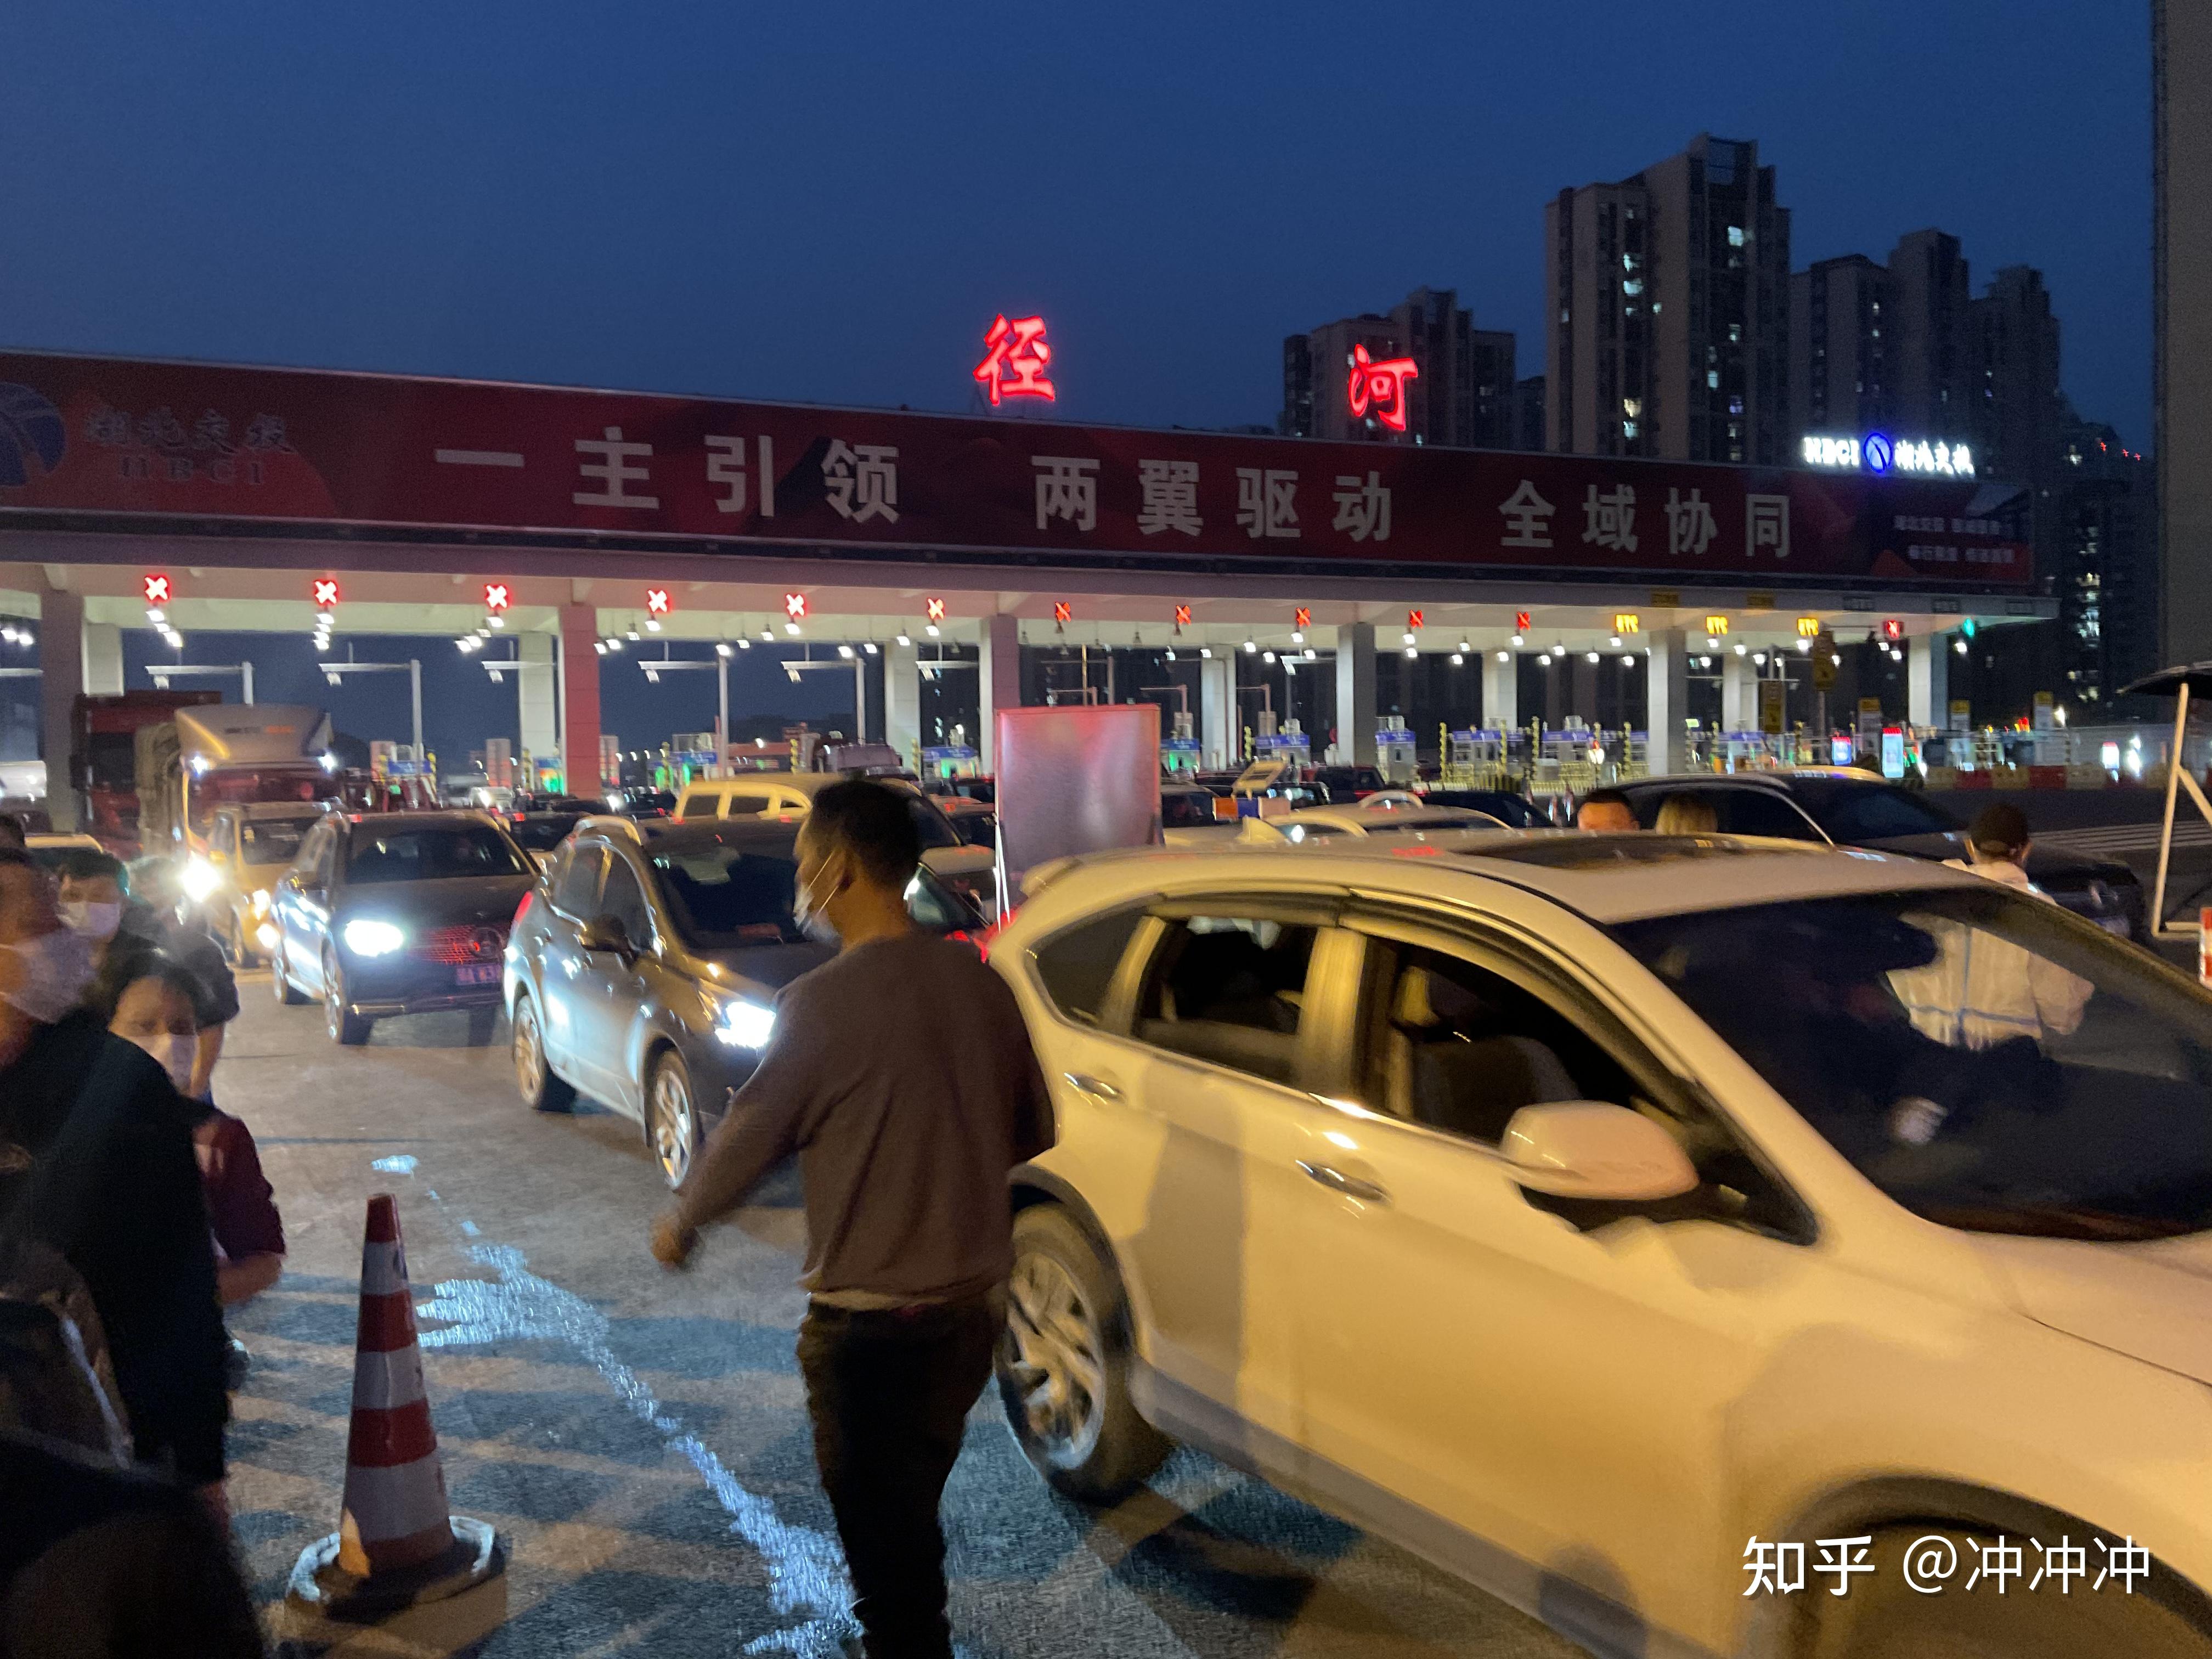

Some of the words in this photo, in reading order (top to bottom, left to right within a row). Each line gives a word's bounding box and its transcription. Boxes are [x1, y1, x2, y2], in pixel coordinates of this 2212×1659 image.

[435, 426, 900, 524] 一主引领
[1031, 456, 1392, 543] 两翼驱动
[1498, 479, 1791, 558] 全域协同
